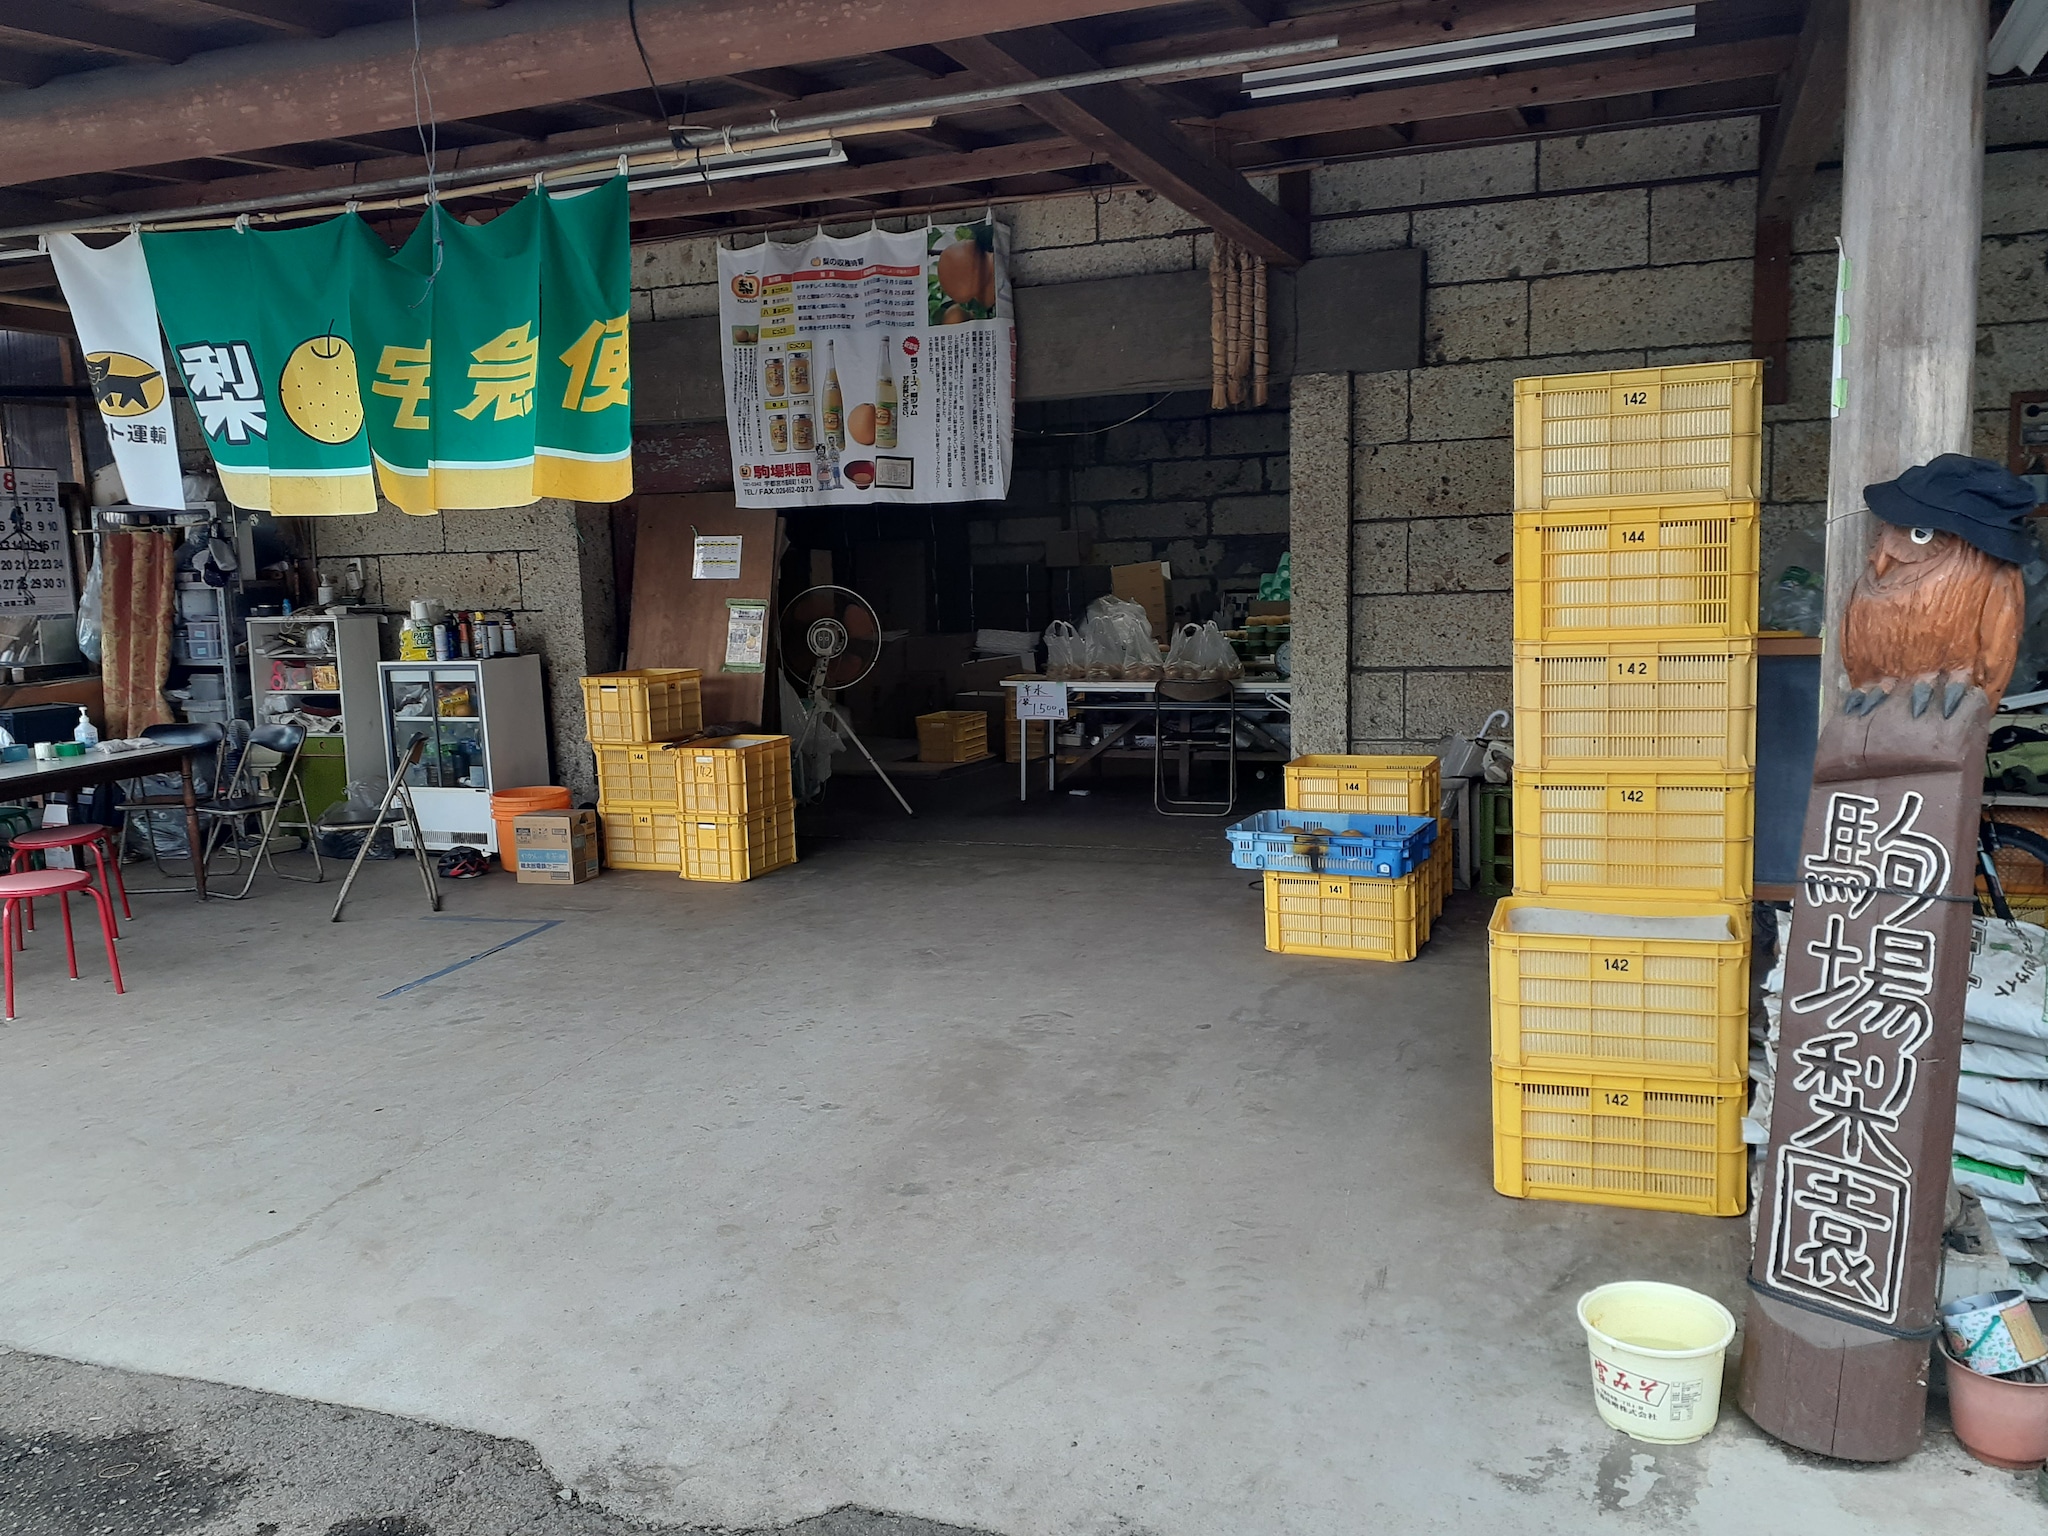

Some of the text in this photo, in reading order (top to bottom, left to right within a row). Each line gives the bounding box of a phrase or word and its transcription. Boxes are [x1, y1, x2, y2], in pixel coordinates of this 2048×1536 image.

[179, 342, 269, 443] 梨
[1622, 392, 1648, 406] 142
[754, 462, 812, 479] 駒場梨園
[4, 472, 16, 490] 8
[35, 502, 42, 512] 2
[47, 502, 54, 512] 3
[38, 522, 44, 532] 9
[48, 522, 58, 531] 10
[1621, 530, 1646, 544] 144
[50, 541, 60, 550] 17
[2, 560, 12, 570] 20
[15, 560, 26, 570] 21
[28, 560, 40, 570] 22
[41, 560, 52, 570] 23
[4, 580, 14, 590] 27
[31, 579, 42, 589] 29
[43, 580, 54, 589] 30
[56, 580, 66, 588] 31
[1617, 662, 1648, 676] 142
[696, 764, 714, 778] 142
[1345, 782, 1360, 792] 144
[1620, 790, 1644, 803] 142
[1329, 885, 1342, 894] 141
[1604, 958, 1629, 972] 142
[1766, 790, 1952, 1325] 駒場梨園
[1604, 1092, 1629, 1107] 142
